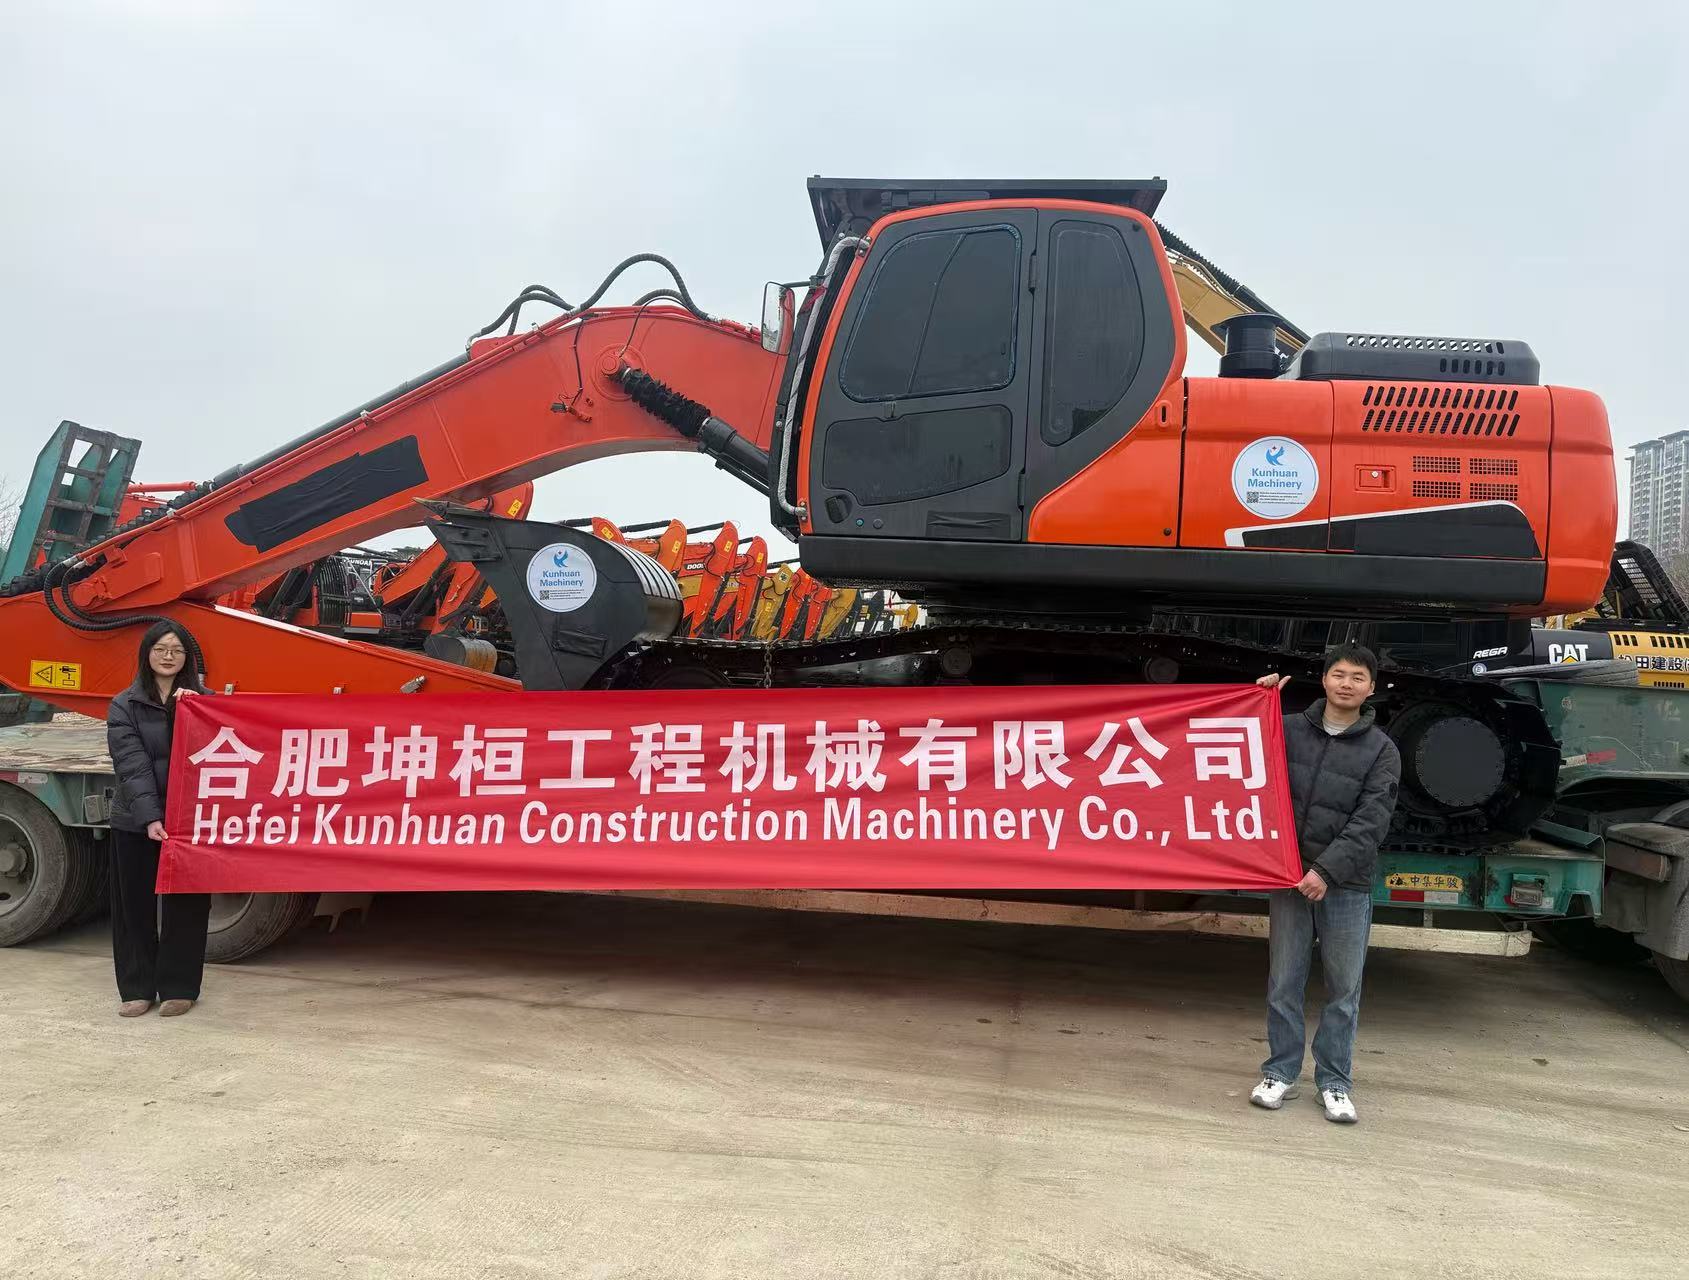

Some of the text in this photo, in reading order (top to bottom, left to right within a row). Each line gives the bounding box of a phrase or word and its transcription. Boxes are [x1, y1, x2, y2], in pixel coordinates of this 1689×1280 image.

[1251, 468, 1298, 478] Kunhuan
[1247, 479, 1302, 490] Machinery
[542, 570, 581, 578] Kunhuan
[539, 579, 584, 587] Machinery
[1472, 646, 1508, 659] REGA
[1548, 643, 1589, 664] CAT
[188, 716, 1267, 799] 合肥坤桓工程机械有限公司
[192, 795, 1279, 850] Hefei Kunhuan Construction Machinery Co., Ltd.
[1410, 875, 1459, 889] 中集华骏
